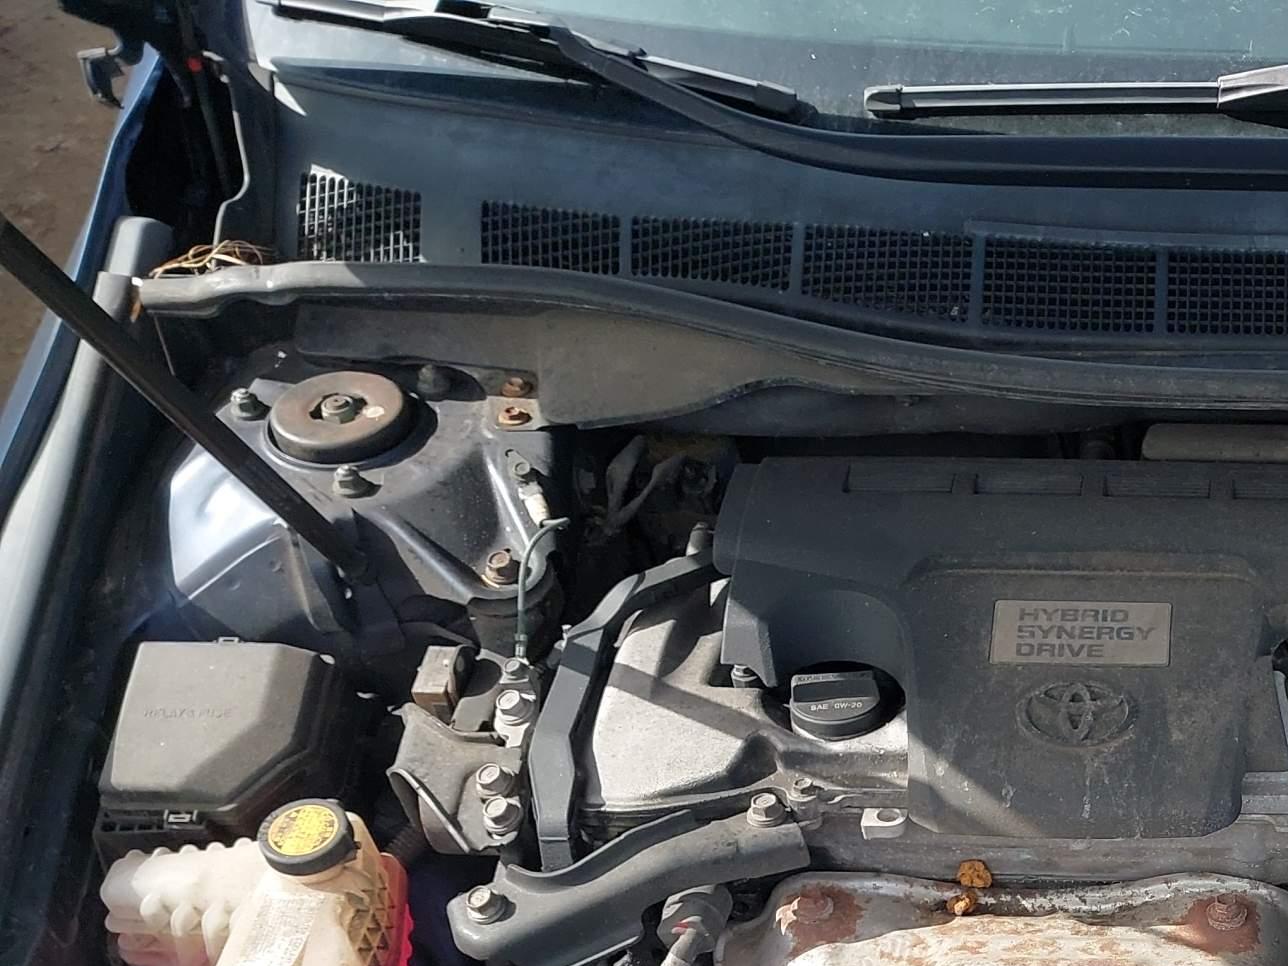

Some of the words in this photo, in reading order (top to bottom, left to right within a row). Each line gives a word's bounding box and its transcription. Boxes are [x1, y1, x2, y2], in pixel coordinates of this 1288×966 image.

[1018, 607, 1129, 623] HYBRID
[1016, 625, 1156, 641] SYNERGY
[1015, 642, 1105, 658] DRIVE
[810, 703, 829, 711] SAE
[834, 701, 863, 710] 0W-20
